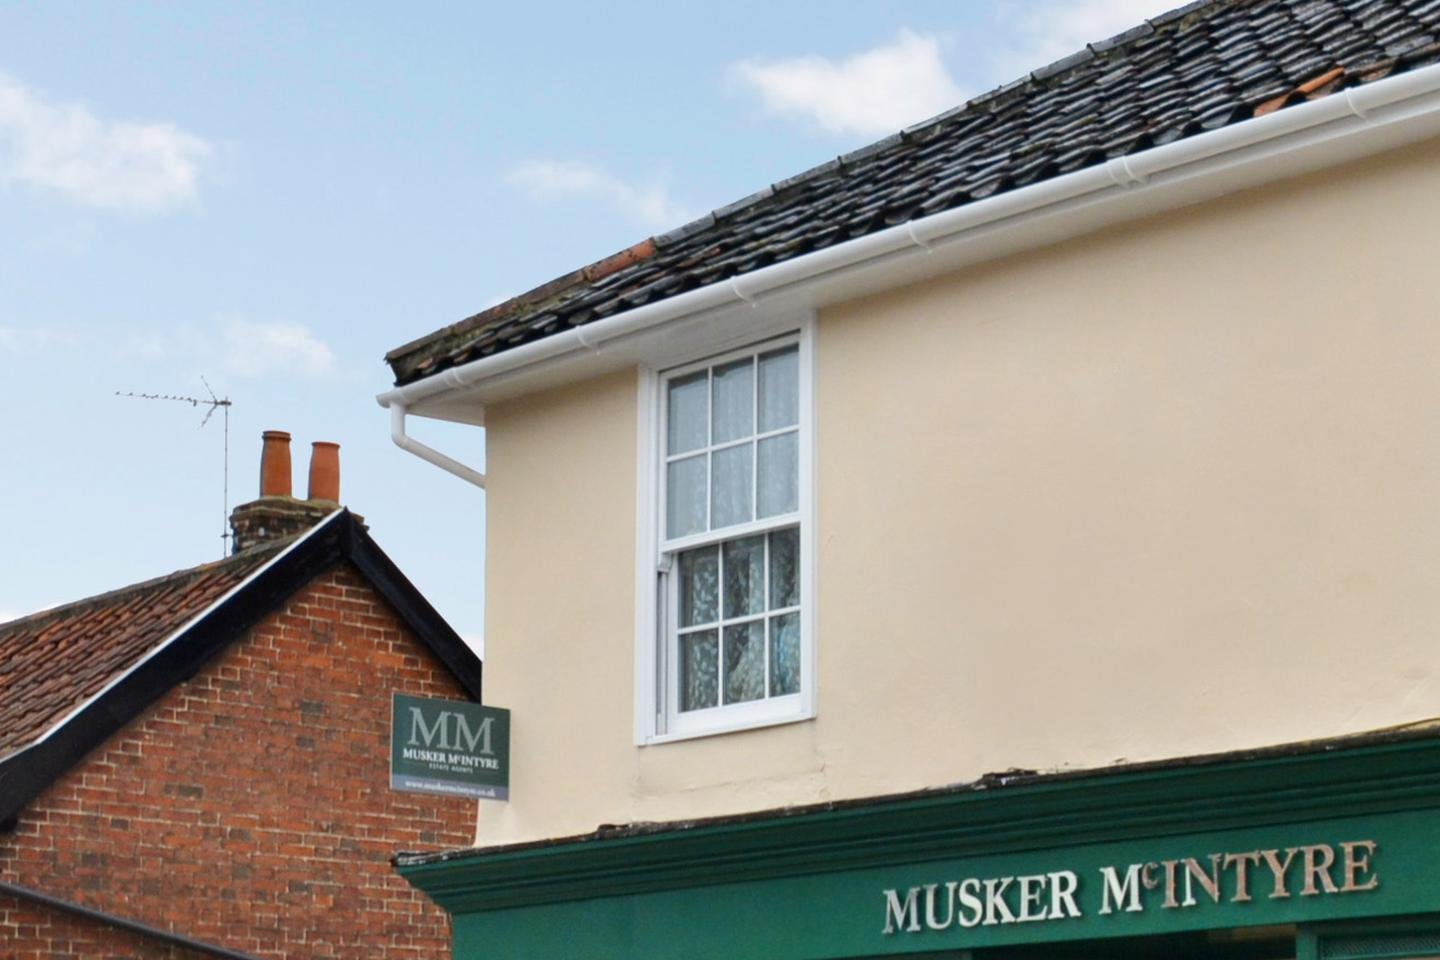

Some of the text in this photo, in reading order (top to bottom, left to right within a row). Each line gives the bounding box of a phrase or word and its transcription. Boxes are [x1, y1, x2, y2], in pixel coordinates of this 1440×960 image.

[407, 706, 495, 755] MM
[402, 748, 446, 763] MUSKER
[882, 869, 1082, 935] MUSKER
